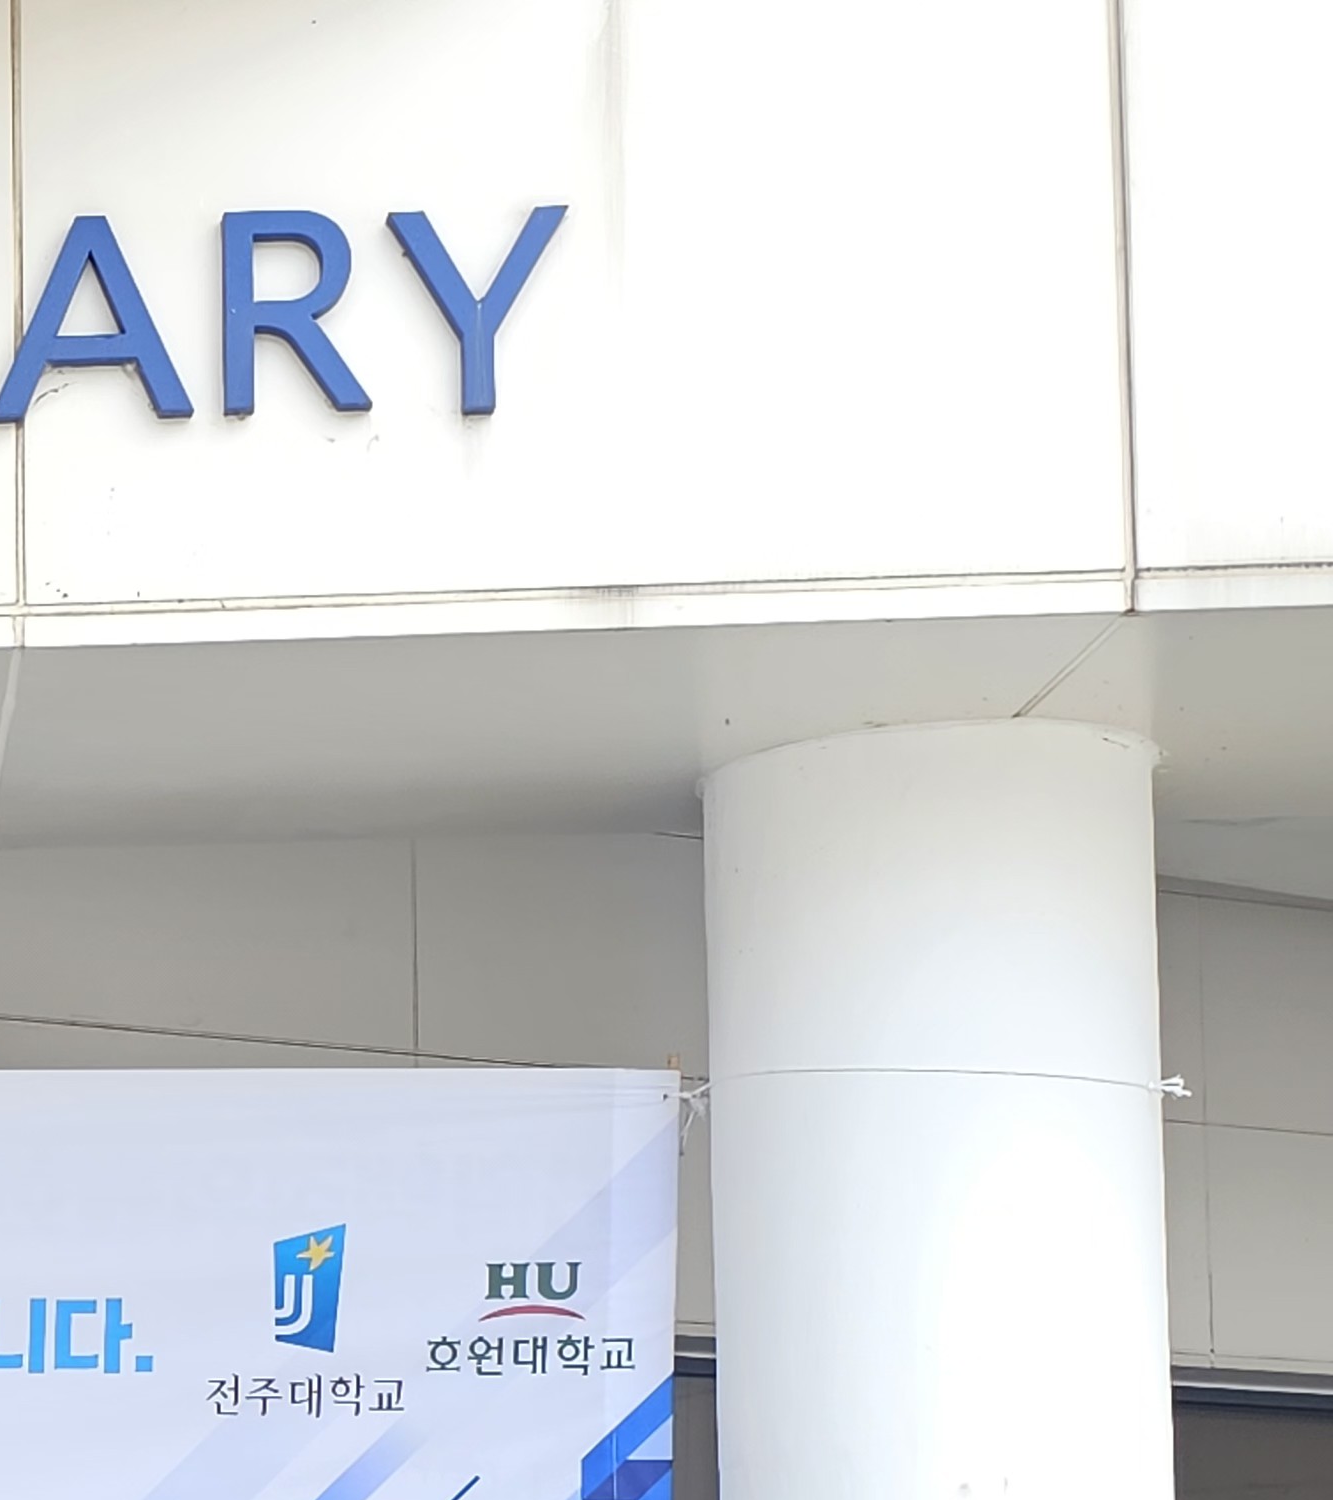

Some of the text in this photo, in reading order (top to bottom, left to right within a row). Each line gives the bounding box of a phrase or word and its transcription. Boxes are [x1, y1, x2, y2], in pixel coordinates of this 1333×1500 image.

[484, 1261, 582, 1300] HU
[425, 1333, 636, 1377] 호원대학교
[205, 1372, 405, 1419] 전주대학교
